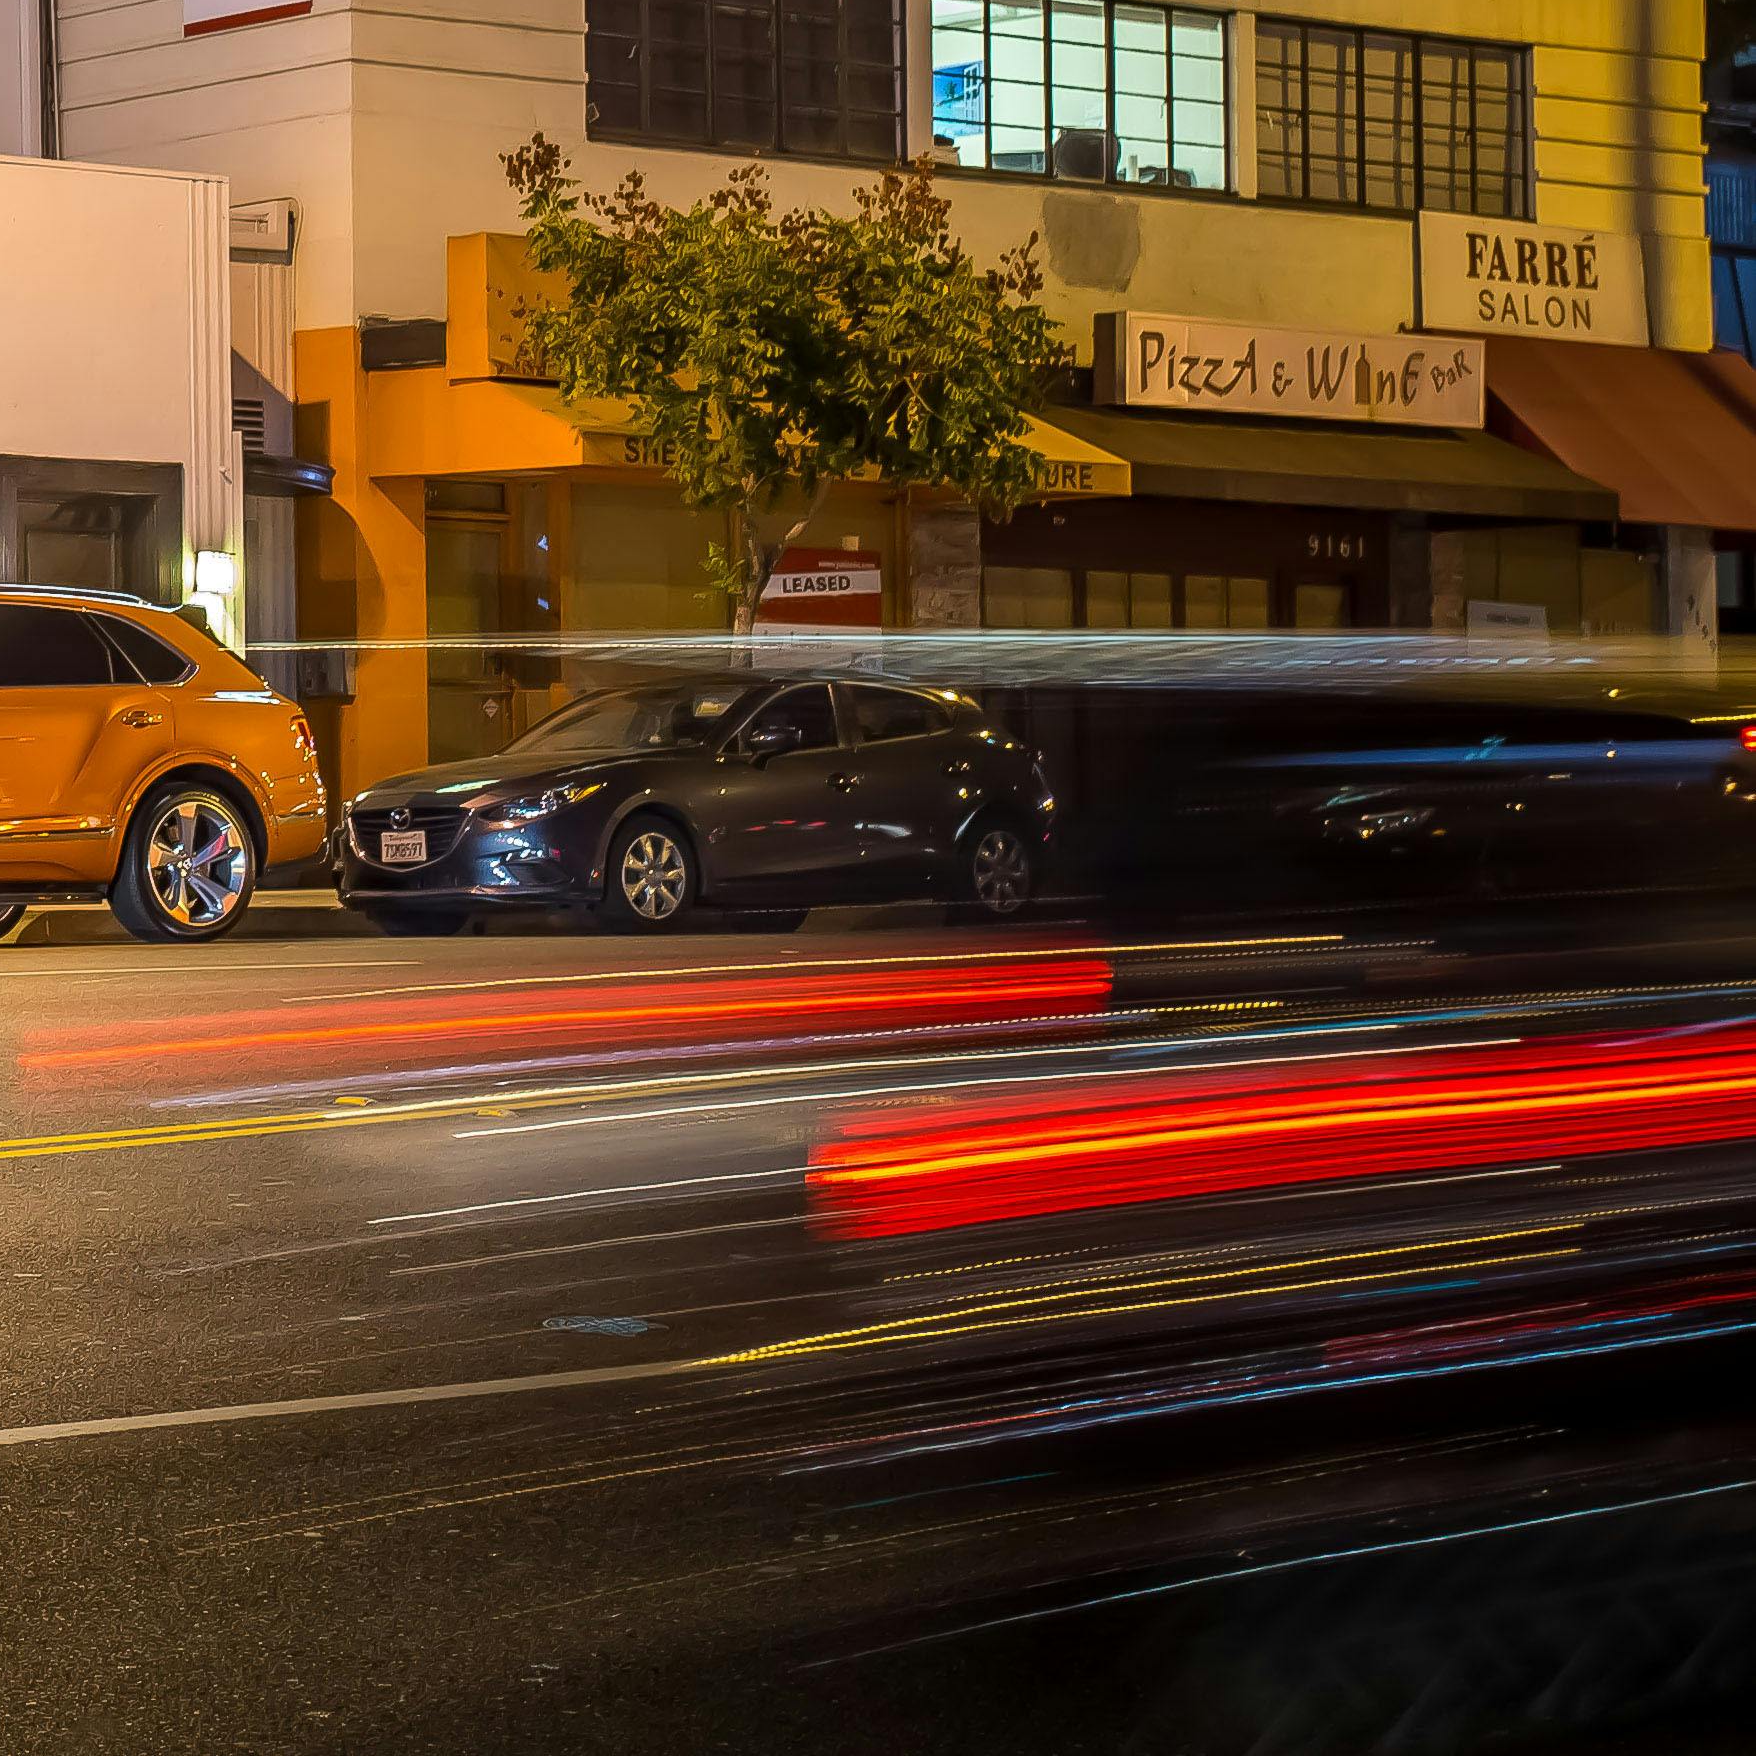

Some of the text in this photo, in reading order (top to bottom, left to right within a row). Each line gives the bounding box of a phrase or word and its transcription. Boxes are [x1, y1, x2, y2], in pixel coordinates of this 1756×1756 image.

[1465, 234, 1599, 291] FARRÉ
[1477, 289, 1593, 331] SALON
[1271, 361, 1294, 398] &
[1308, 534, 1363, 558] 9161
[781, 575, 851, 594] LEASED
